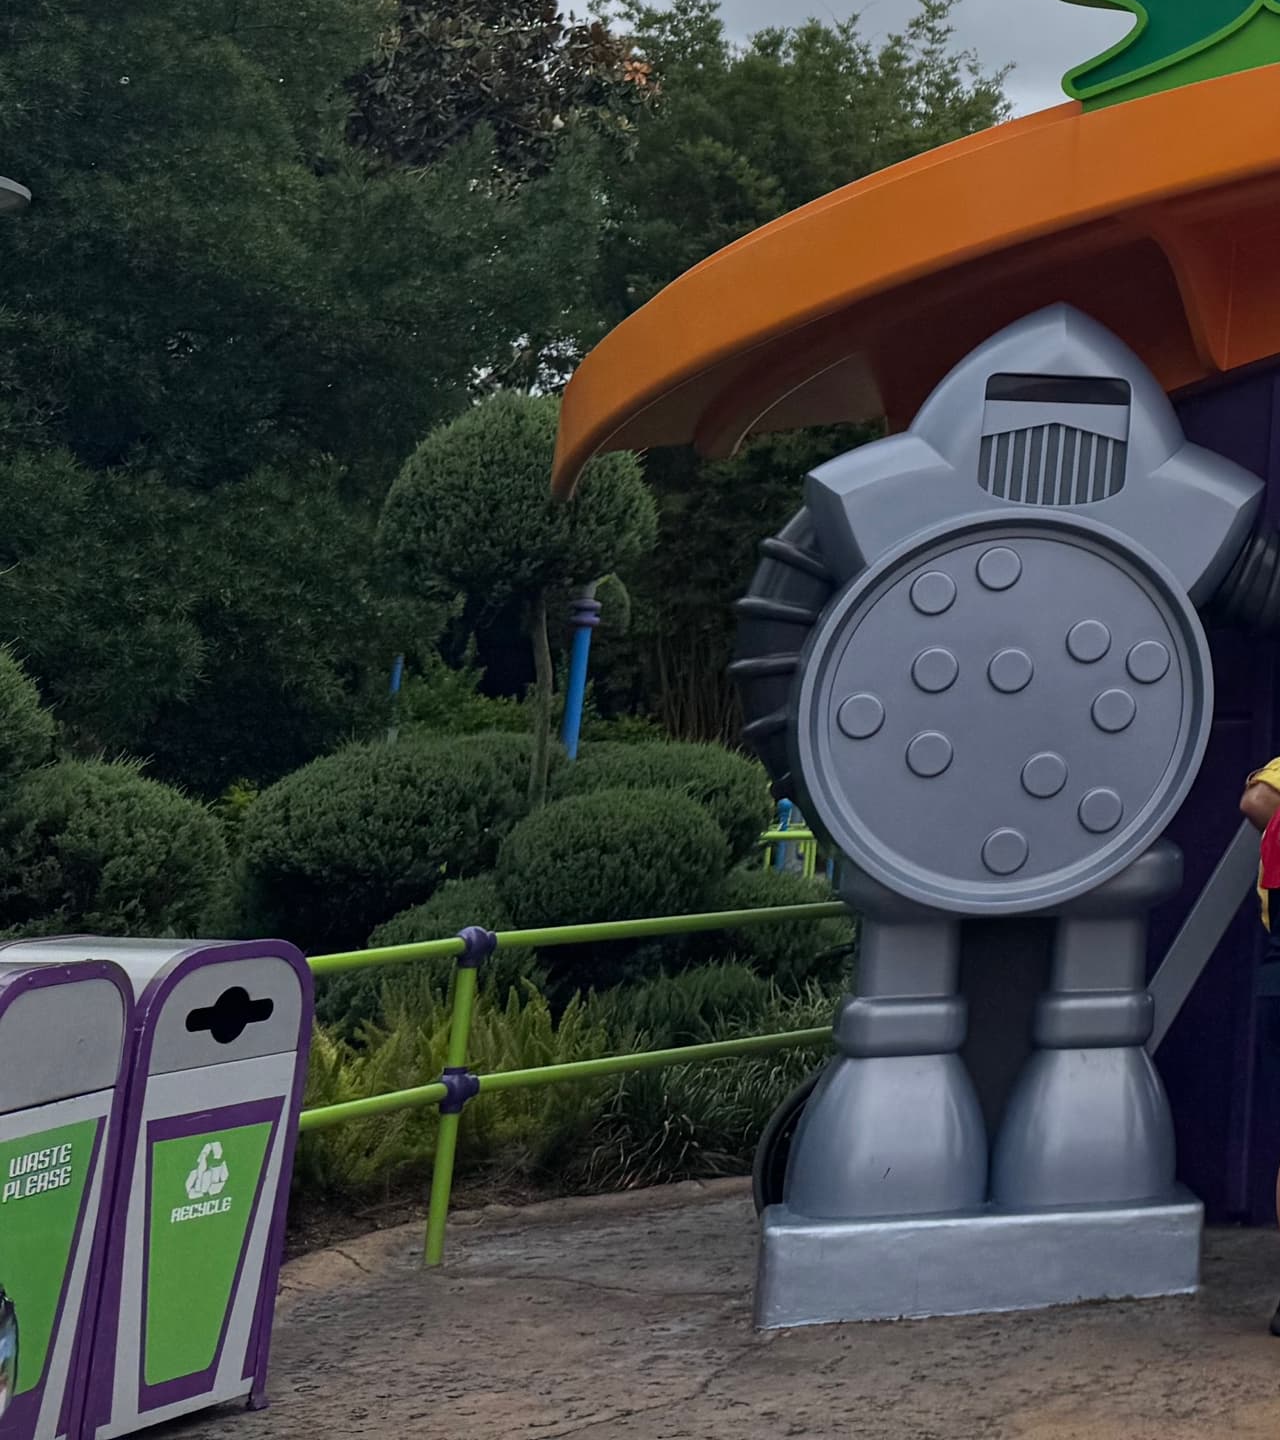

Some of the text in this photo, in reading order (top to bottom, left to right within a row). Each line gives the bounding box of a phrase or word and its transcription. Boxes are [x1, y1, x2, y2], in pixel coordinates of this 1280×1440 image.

[9, 1143, 72, 1178] WASTE
[2, 1165, 72, 1203] PLEASE
[171, 1196, 232, 1224] RECYCLE
